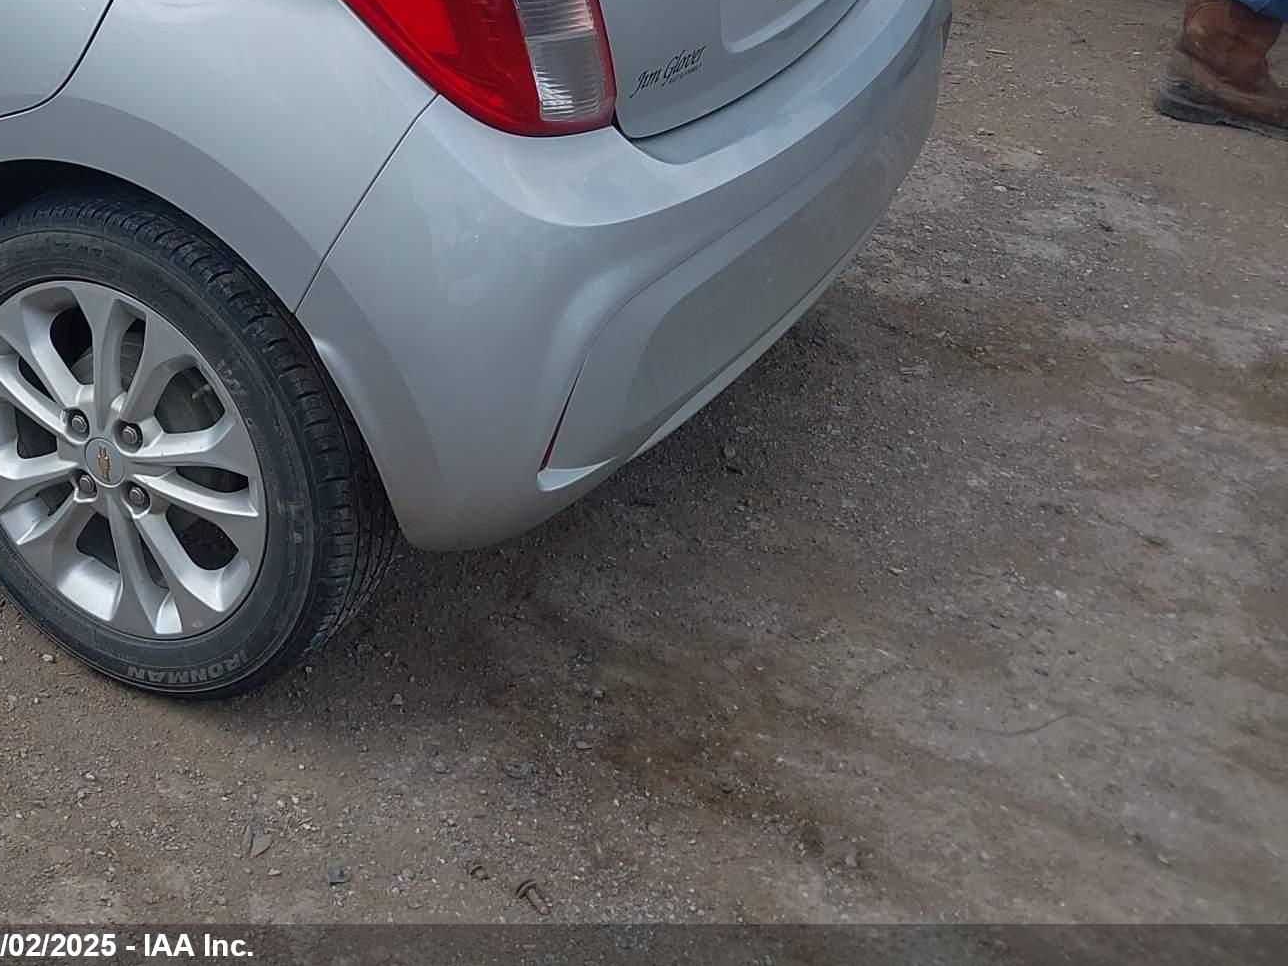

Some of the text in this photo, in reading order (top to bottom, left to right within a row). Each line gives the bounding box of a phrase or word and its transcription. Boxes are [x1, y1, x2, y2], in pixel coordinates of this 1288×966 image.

[629, 46, 706, 98] Jim Glover
[127, 649, 249, 683] IRONMAN
